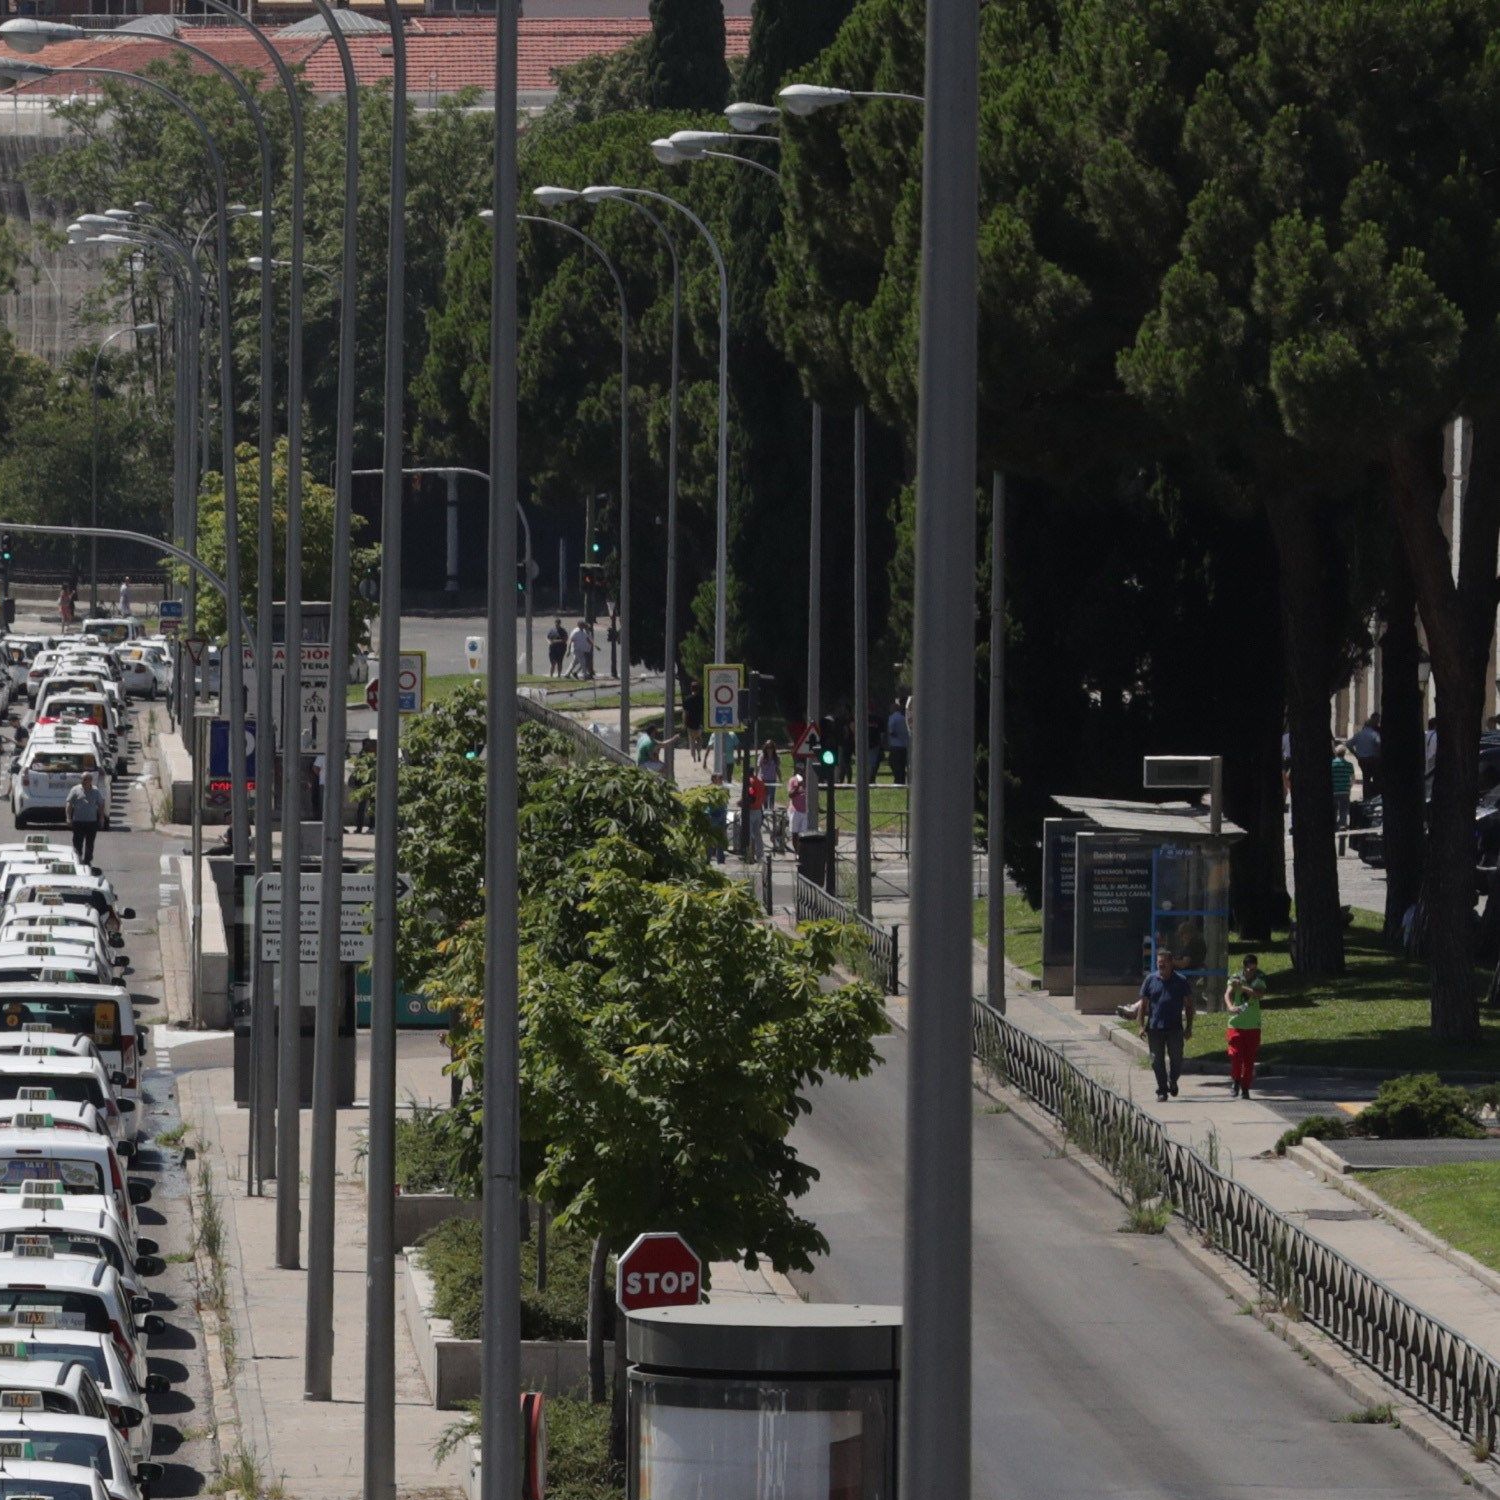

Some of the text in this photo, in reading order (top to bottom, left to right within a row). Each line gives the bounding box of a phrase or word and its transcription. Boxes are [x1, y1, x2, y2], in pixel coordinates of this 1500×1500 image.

[303, 705, 326, 713] TAXI
[1093, 851, 1126, 861] Booking
[625, 1271, 695, 1294] STOP
